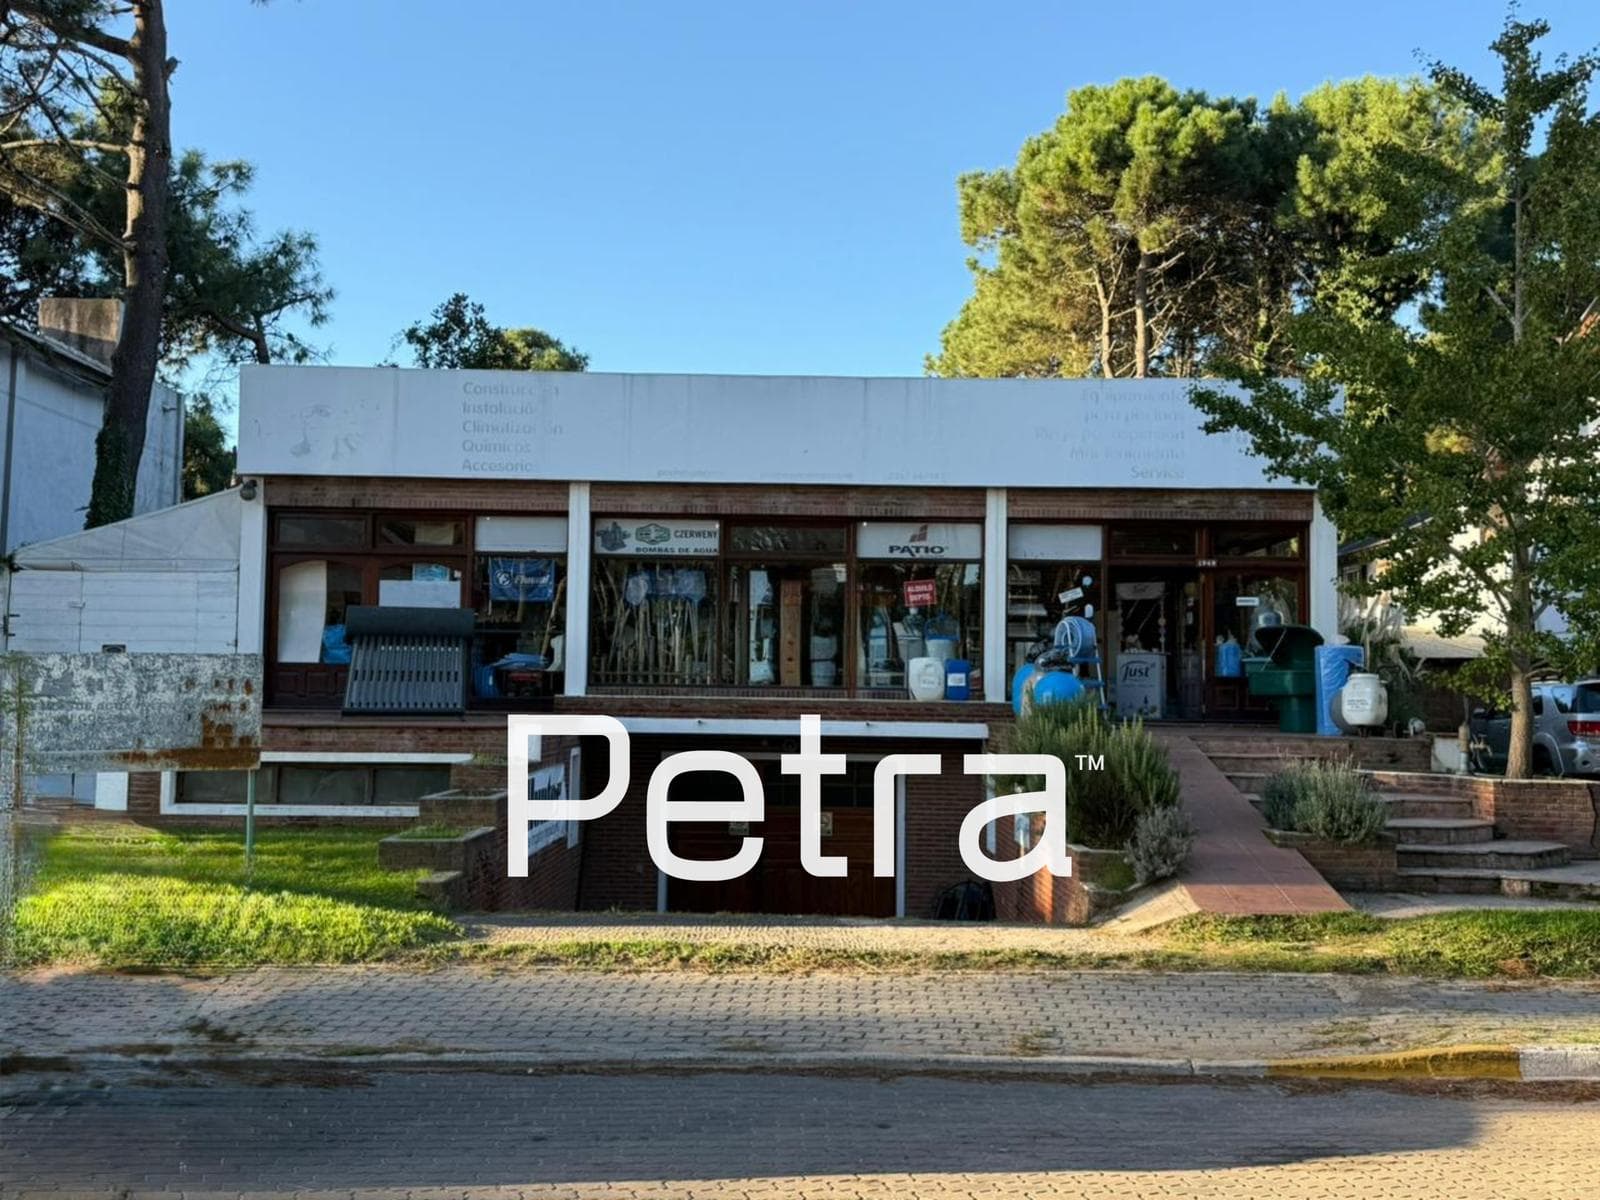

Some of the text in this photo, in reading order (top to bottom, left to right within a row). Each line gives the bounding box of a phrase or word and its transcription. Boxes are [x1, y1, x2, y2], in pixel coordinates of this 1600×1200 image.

[673, 528, 718, 539] CZERWENY
[635, 545, 719, 554] BOMBAS DE AGUA
[888, 544, 946, 558] PATIO
[1121, 662, 1151, 682] Just
